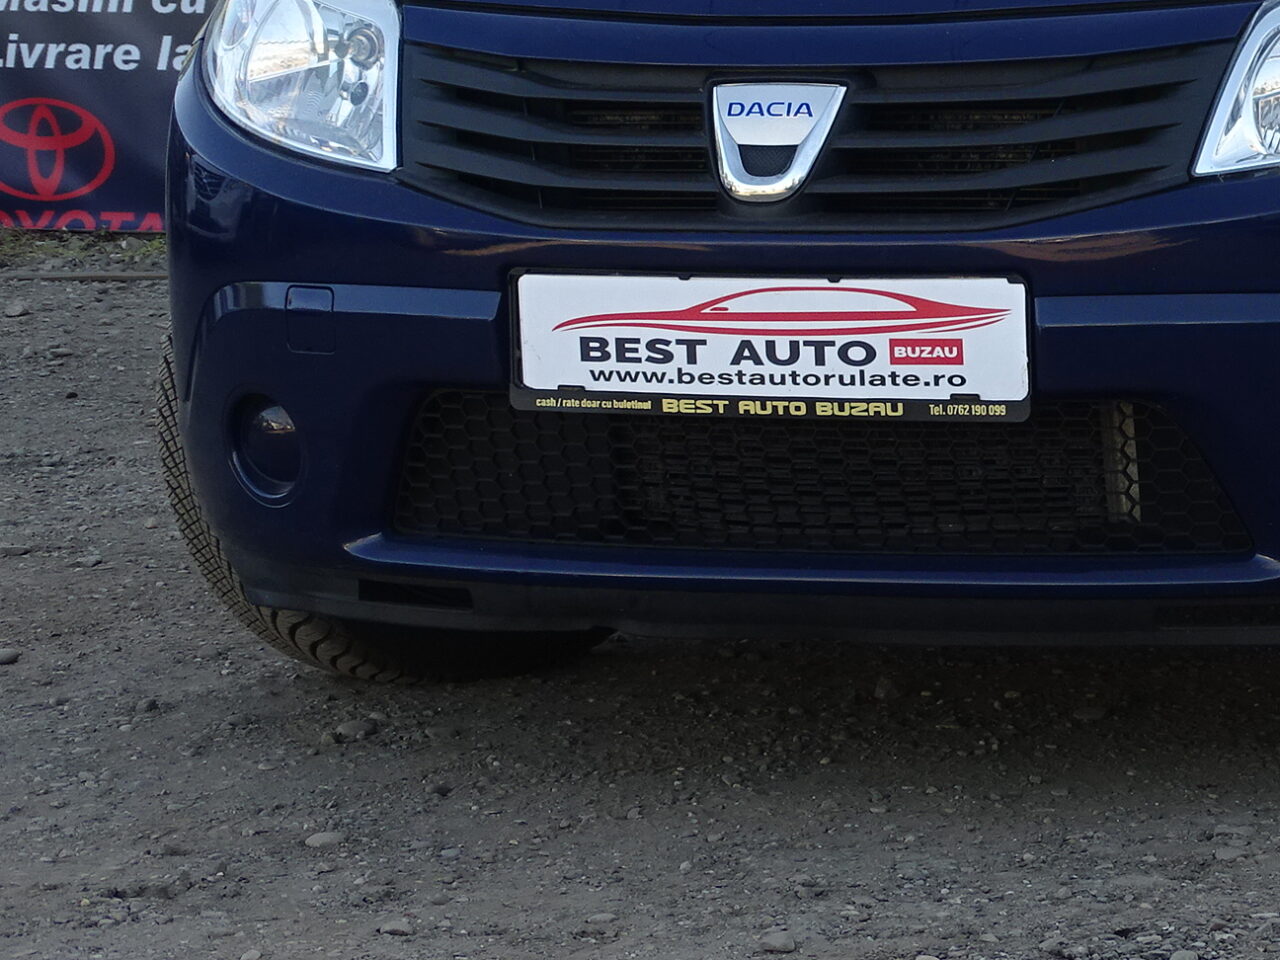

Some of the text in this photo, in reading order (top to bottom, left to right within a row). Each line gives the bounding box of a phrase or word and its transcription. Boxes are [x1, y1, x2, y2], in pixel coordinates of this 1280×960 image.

[0, 33, 141, 72] ivrare
[727, 101, 814, 118] DACIA
[579, 336, 958, 367] BEST AUTO BUZAU
[589, 367, 967, 387] www.bestautorulate.ro
[536, 397, 556, 408] cash
[562, 398, 580, 408] rate
[581, 398, 600, 409] doar
[601, 401, 612, 409] cu
[661, 398, 729, 414] BEST
[738, 400, 807, 415] AUTO
[815, 401, 904, 416] BUZAU
[929, 404, 946, 416] Tel.
[947, 404, 970, 416] 0762
[971, 405, 987, 416] 190
[988, 405, 1006, 416] 099
